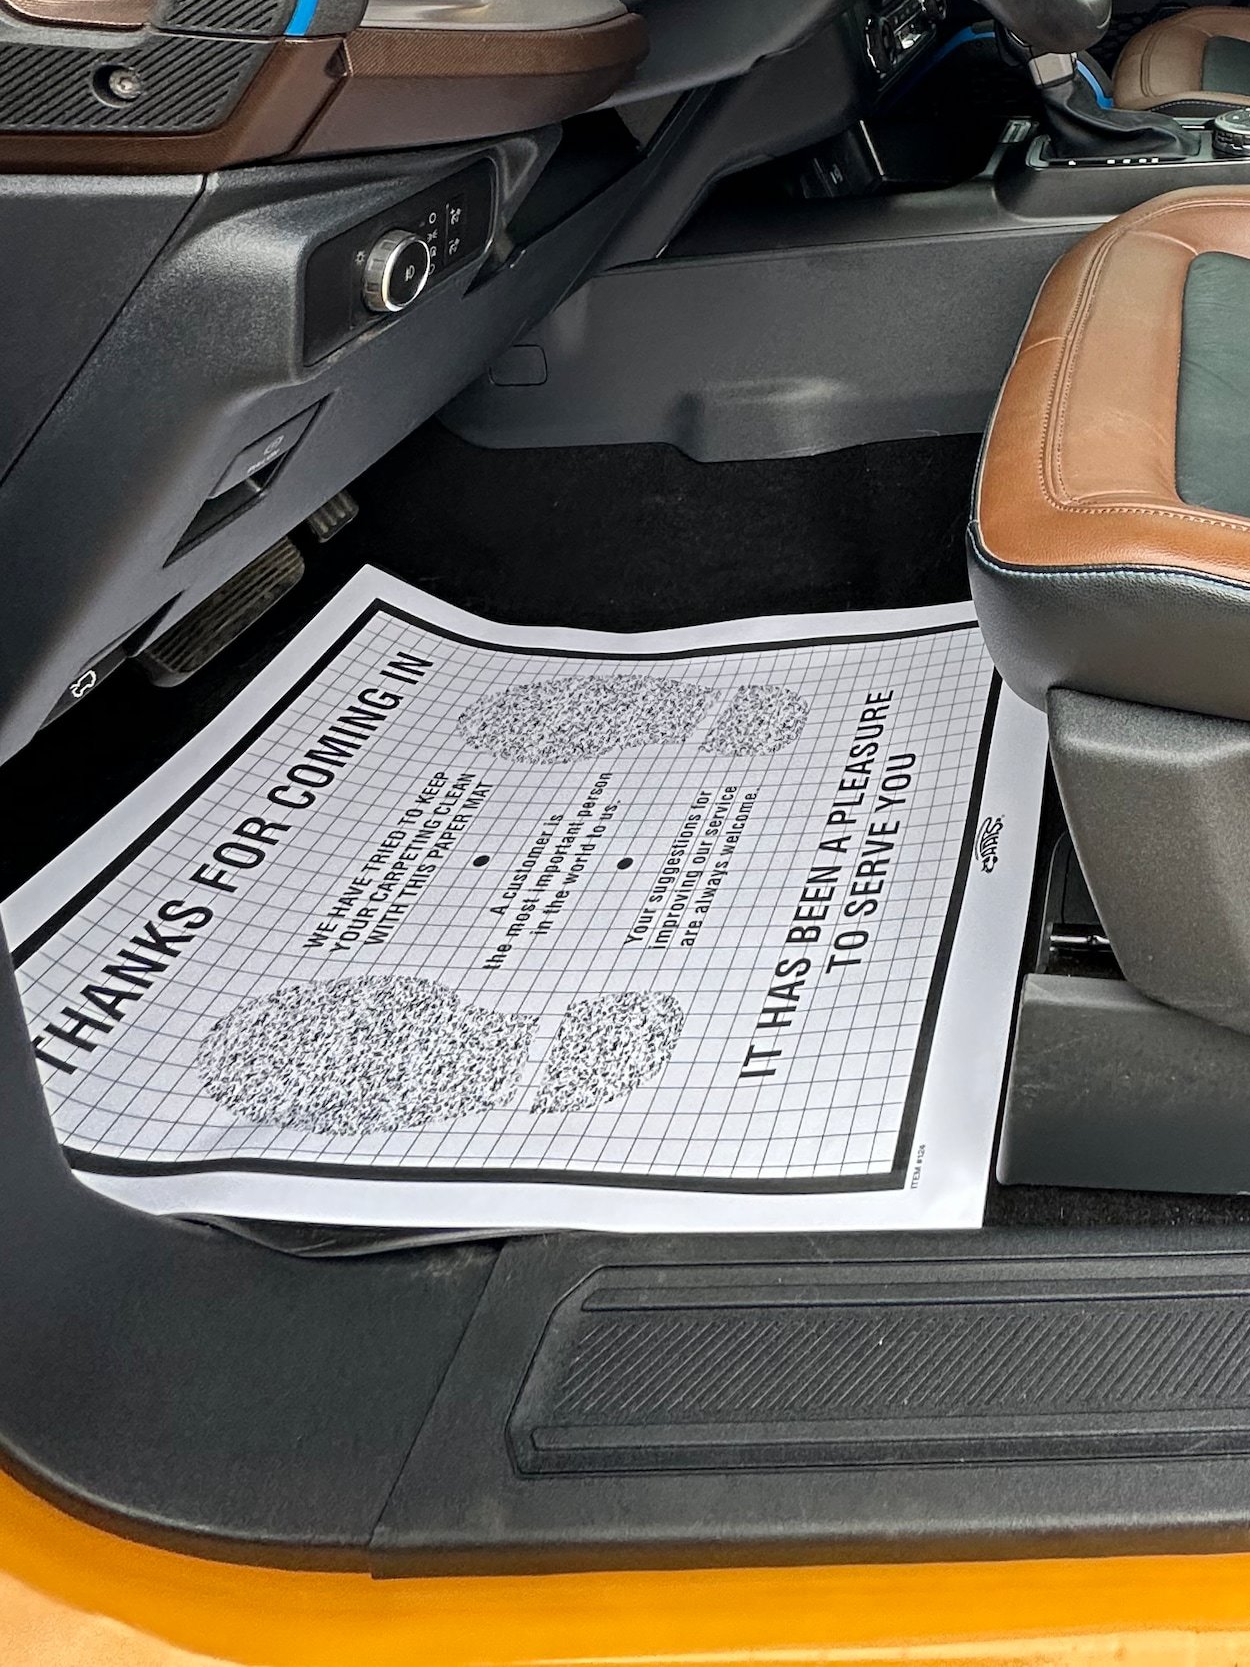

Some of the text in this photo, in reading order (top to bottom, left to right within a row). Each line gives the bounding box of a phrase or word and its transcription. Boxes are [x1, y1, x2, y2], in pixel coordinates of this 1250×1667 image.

[32, 651, 434, 1075] THANKS FOR COMING IN
[303, 771, 449, 949] WE HAVE TRIED TO KEEP
[329, 772, 476, 954] YOUR CARPETING CLEAN
[363, 781, 494, 946] WITH THIS PAPER MAT
[482, 771, 613, 970] the most important person
[490, 813, 564, 916] A customer is
[528, 800, 622, 936] in the world to us.
[623, 790, 712, 945] Your suggestions for
[648, 786, 737, 949] improving our service
[680, 787, 760, 947] are always welcome.
[739, 689, 894, 1079] IT HAS BEEN A PLEASURE
[826, 752, 916, 974] TO SERVE YOU
[910, 1166, 921, 1189] ITEM
